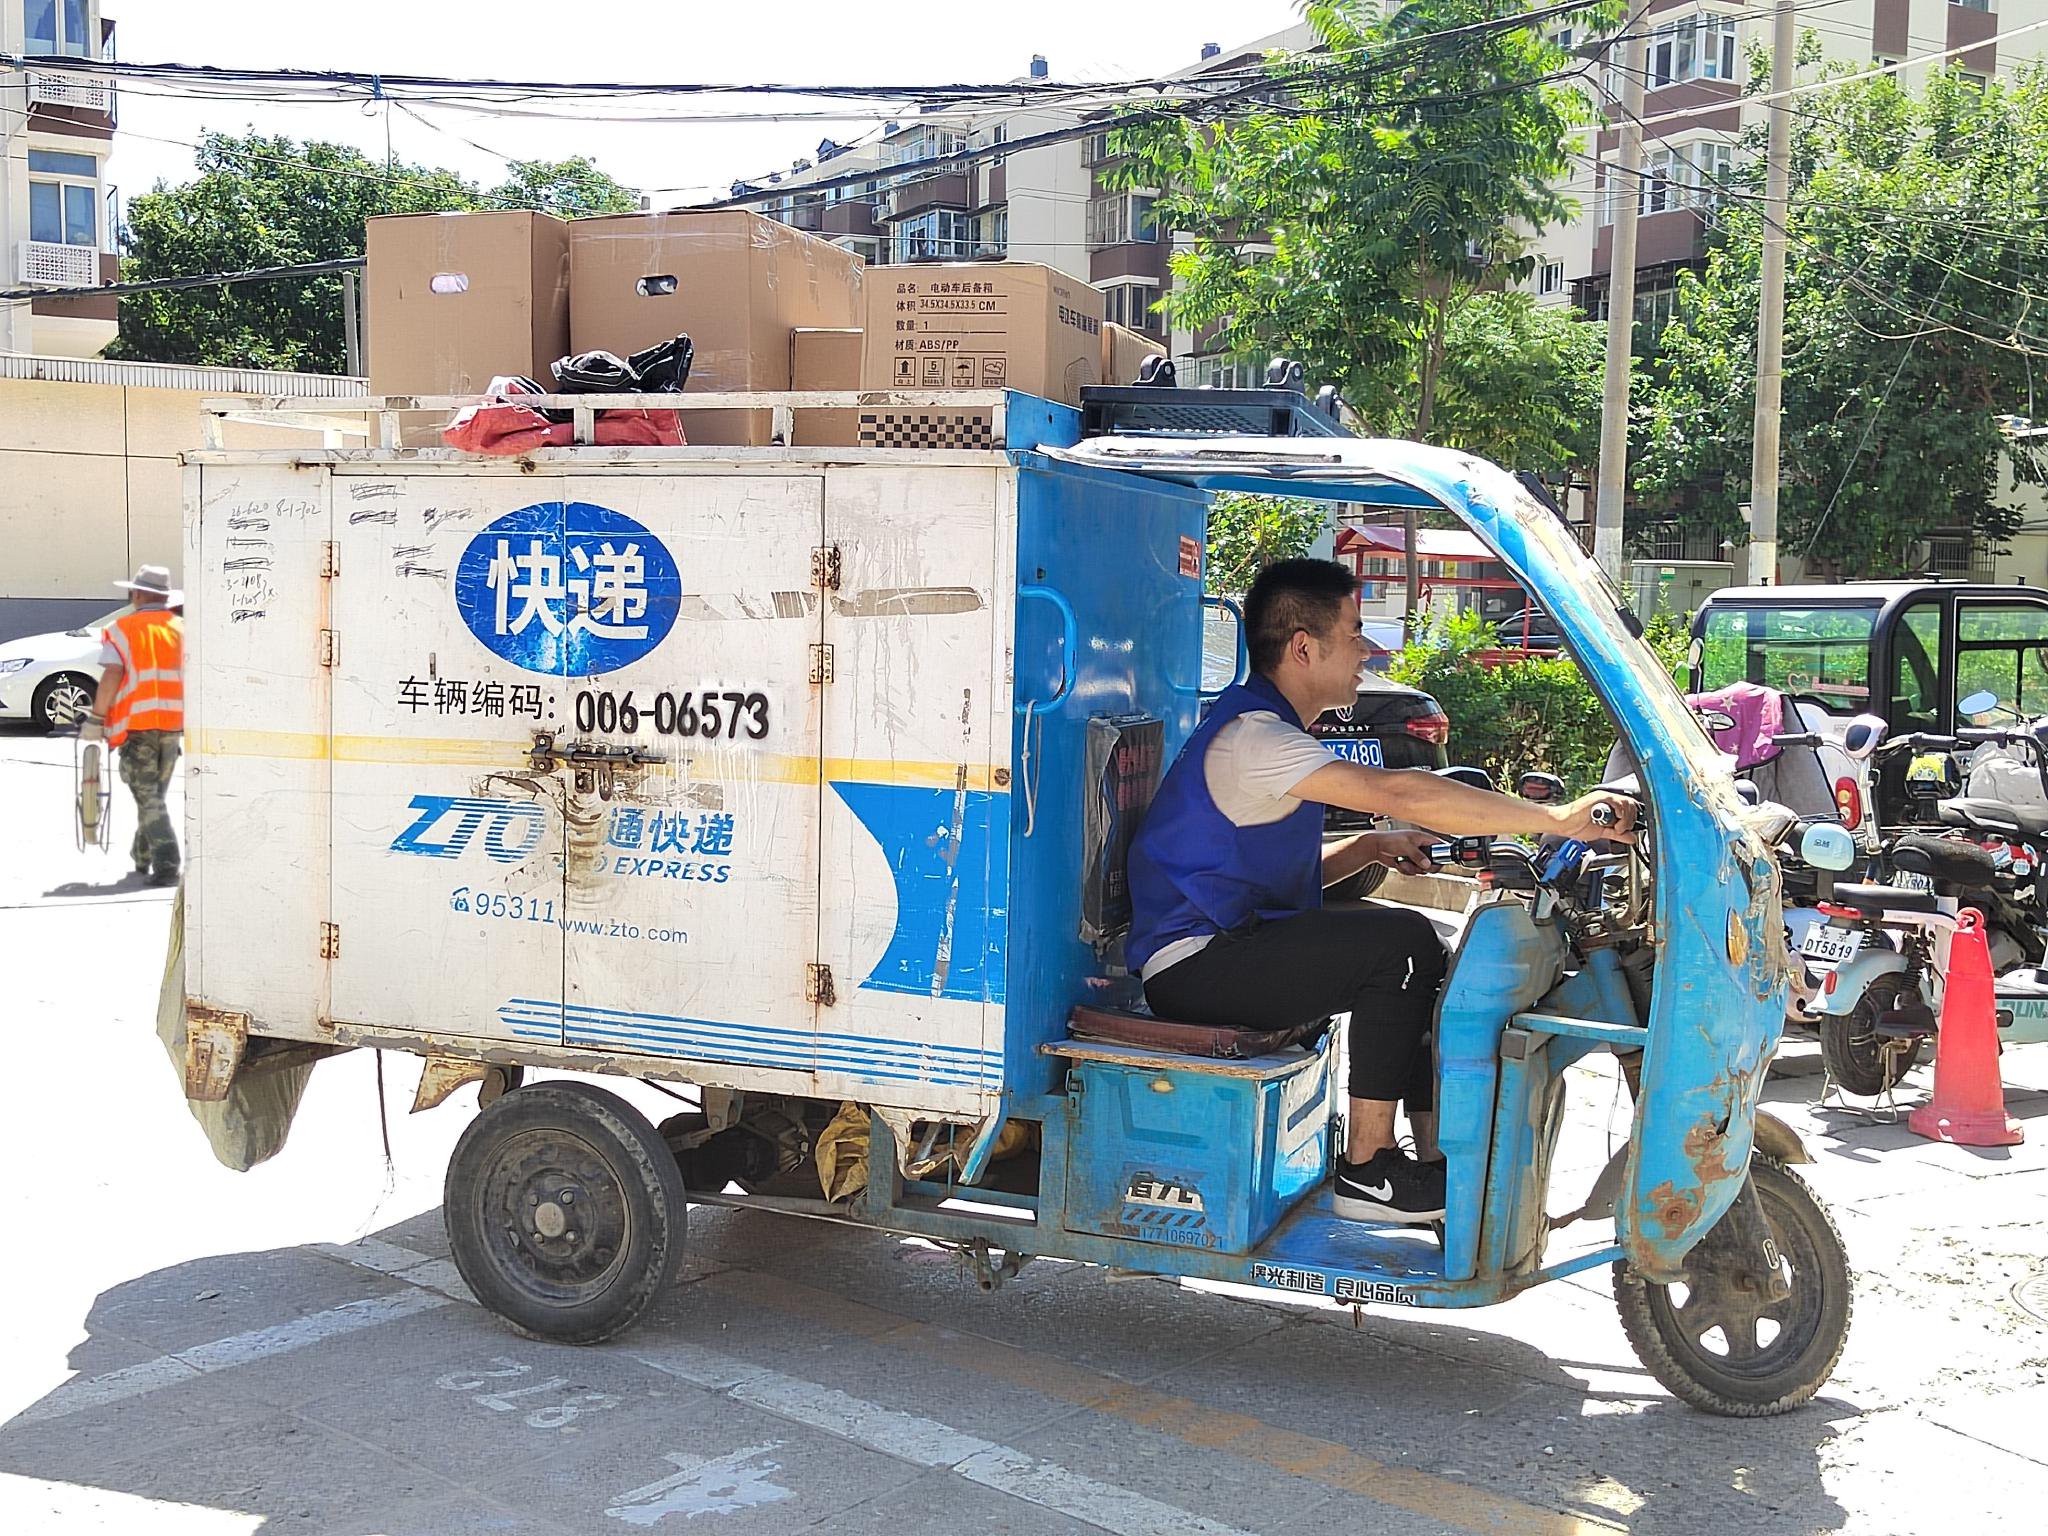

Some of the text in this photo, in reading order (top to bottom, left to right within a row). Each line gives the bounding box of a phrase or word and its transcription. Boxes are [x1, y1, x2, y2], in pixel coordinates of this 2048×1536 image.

[931, 282, 993, 294] 电动车后备箱
[978, 301, 996, 311] CM
[923, 321, 928, 330] 1
[919, 340, 960, 350] ABS/PP
[486, 538, 650, 641] 快递
[397, 675, 770, 740] 车辆编码： 006-06573
[1322, 724, 1371, 733] PASSAT
[388, 794, 546, 864] ZTO
[603, 806, 736, 857] 通快递
[613, 856, 732, 884] EXPRESS
[474, 891, 555, 925] 95311
[557, 917, 690, 945] www.zto.com
[1804, 938, 1853, 959] DT5819
